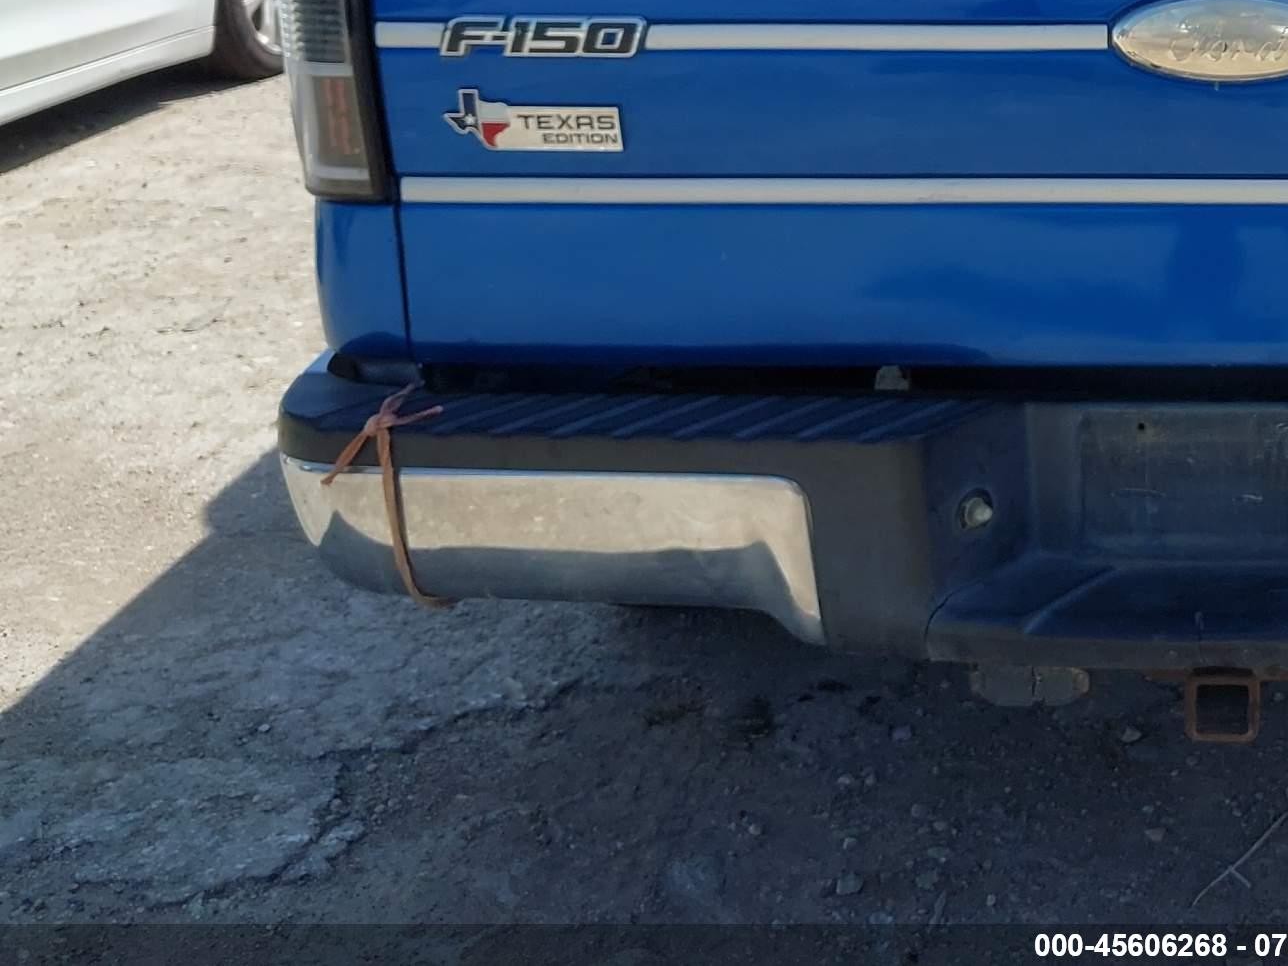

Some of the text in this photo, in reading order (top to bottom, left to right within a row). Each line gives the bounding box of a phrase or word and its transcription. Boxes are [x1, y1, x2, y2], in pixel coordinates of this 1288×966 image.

[440, 13, 647, 58] F-150
[516, 114, 615, 130] TEXAS
[543, 133, 618, 144] EDITION
